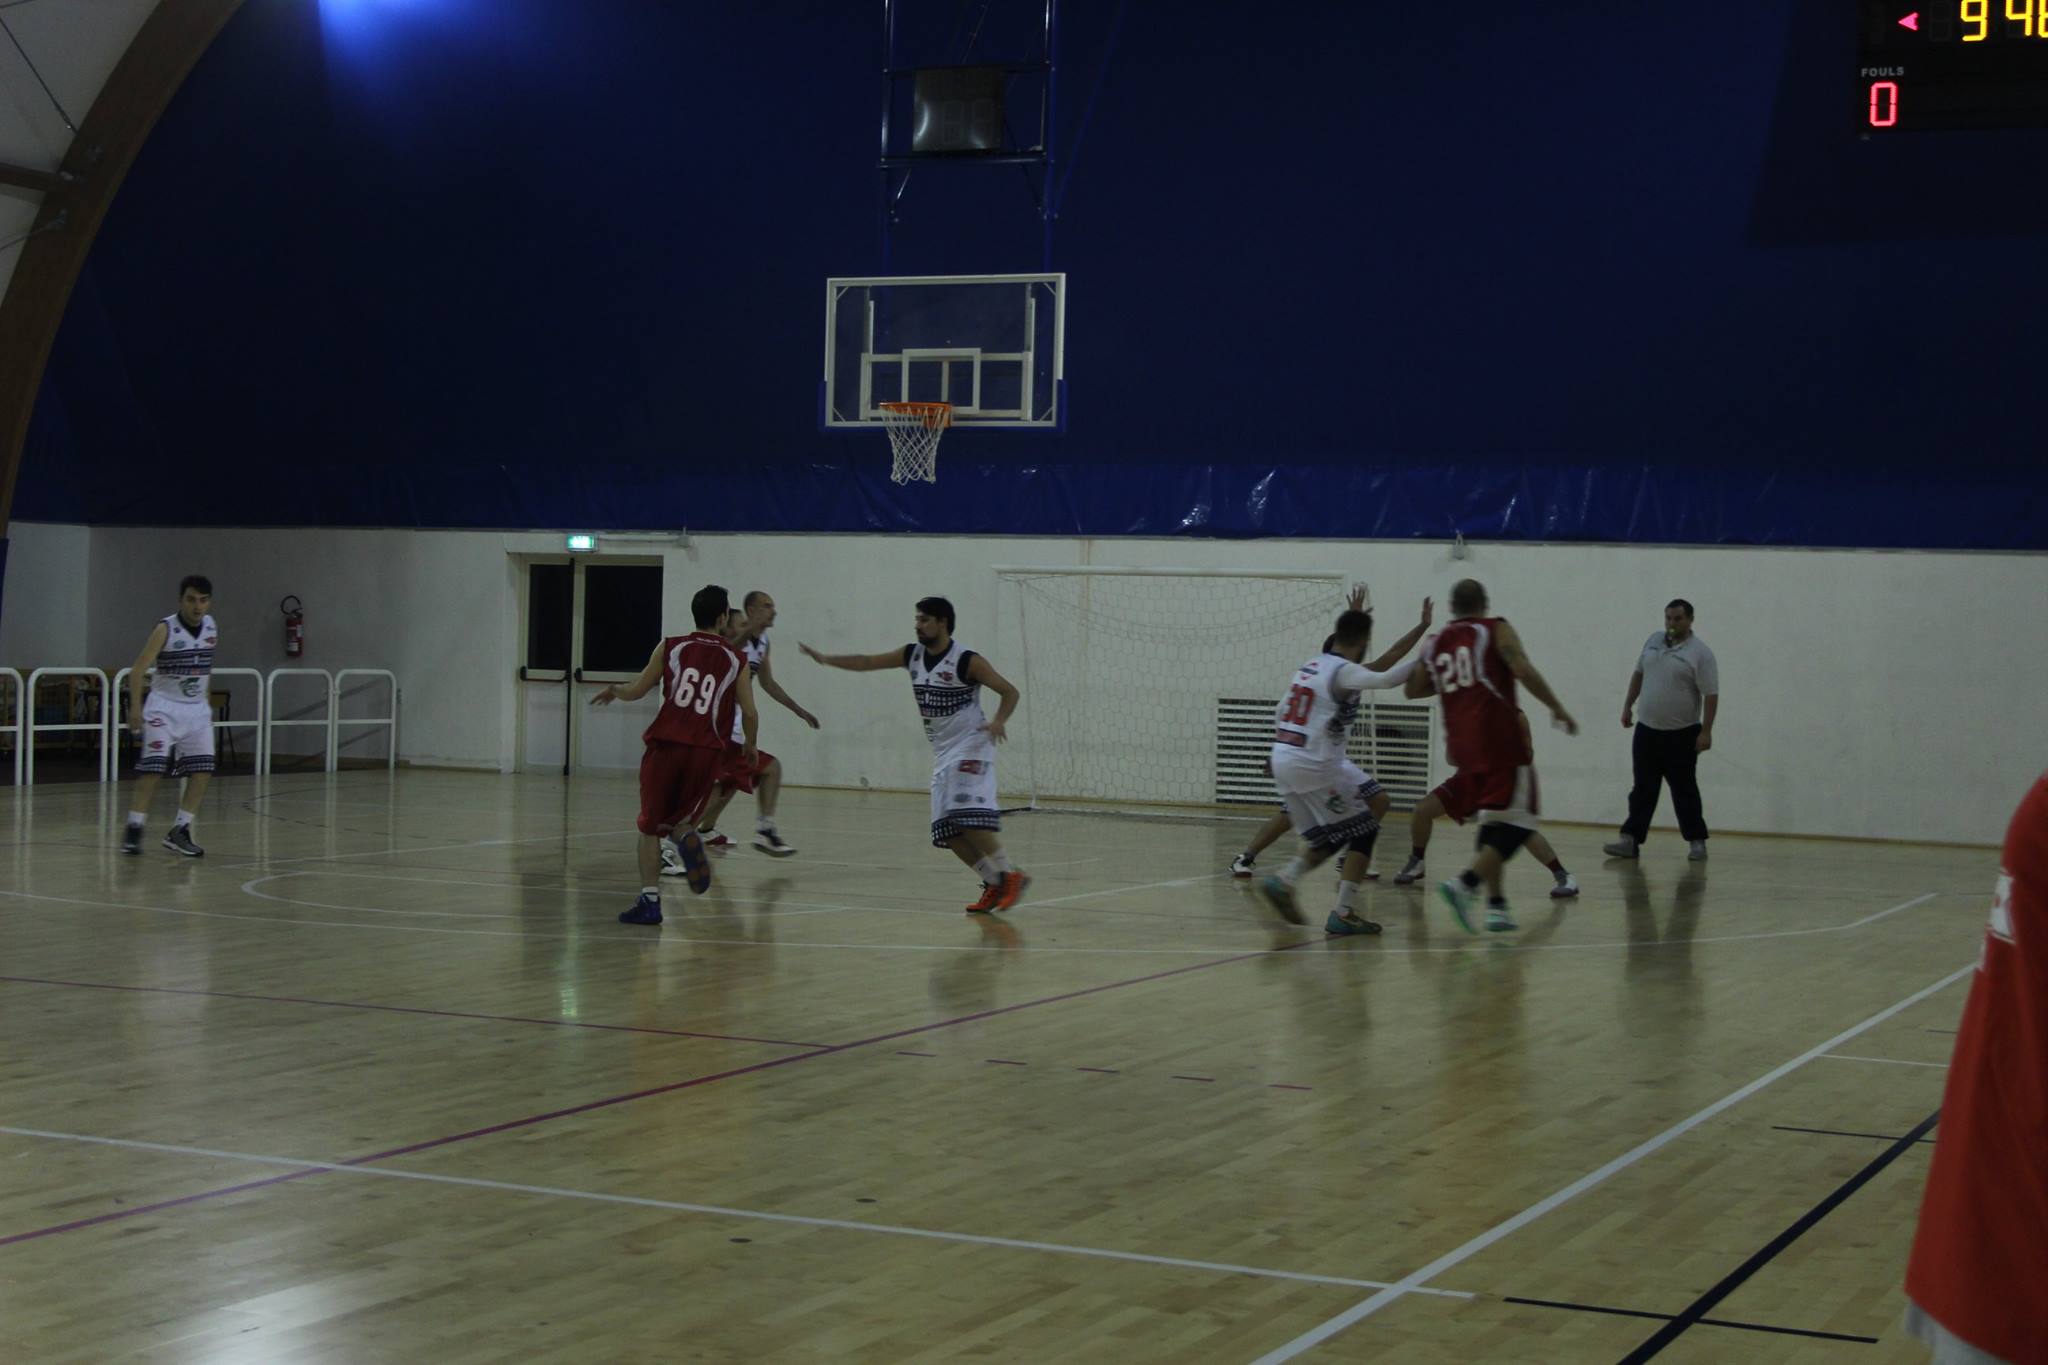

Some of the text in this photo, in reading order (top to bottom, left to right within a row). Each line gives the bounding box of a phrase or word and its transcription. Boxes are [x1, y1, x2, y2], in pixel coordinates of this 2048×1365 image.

[1861, 66, 1905, 78] FOULS
[1869, 81, 1899, 128] 0
[674, 667, 716, 716] 69
[1435, 646, 1476, 694] 20
